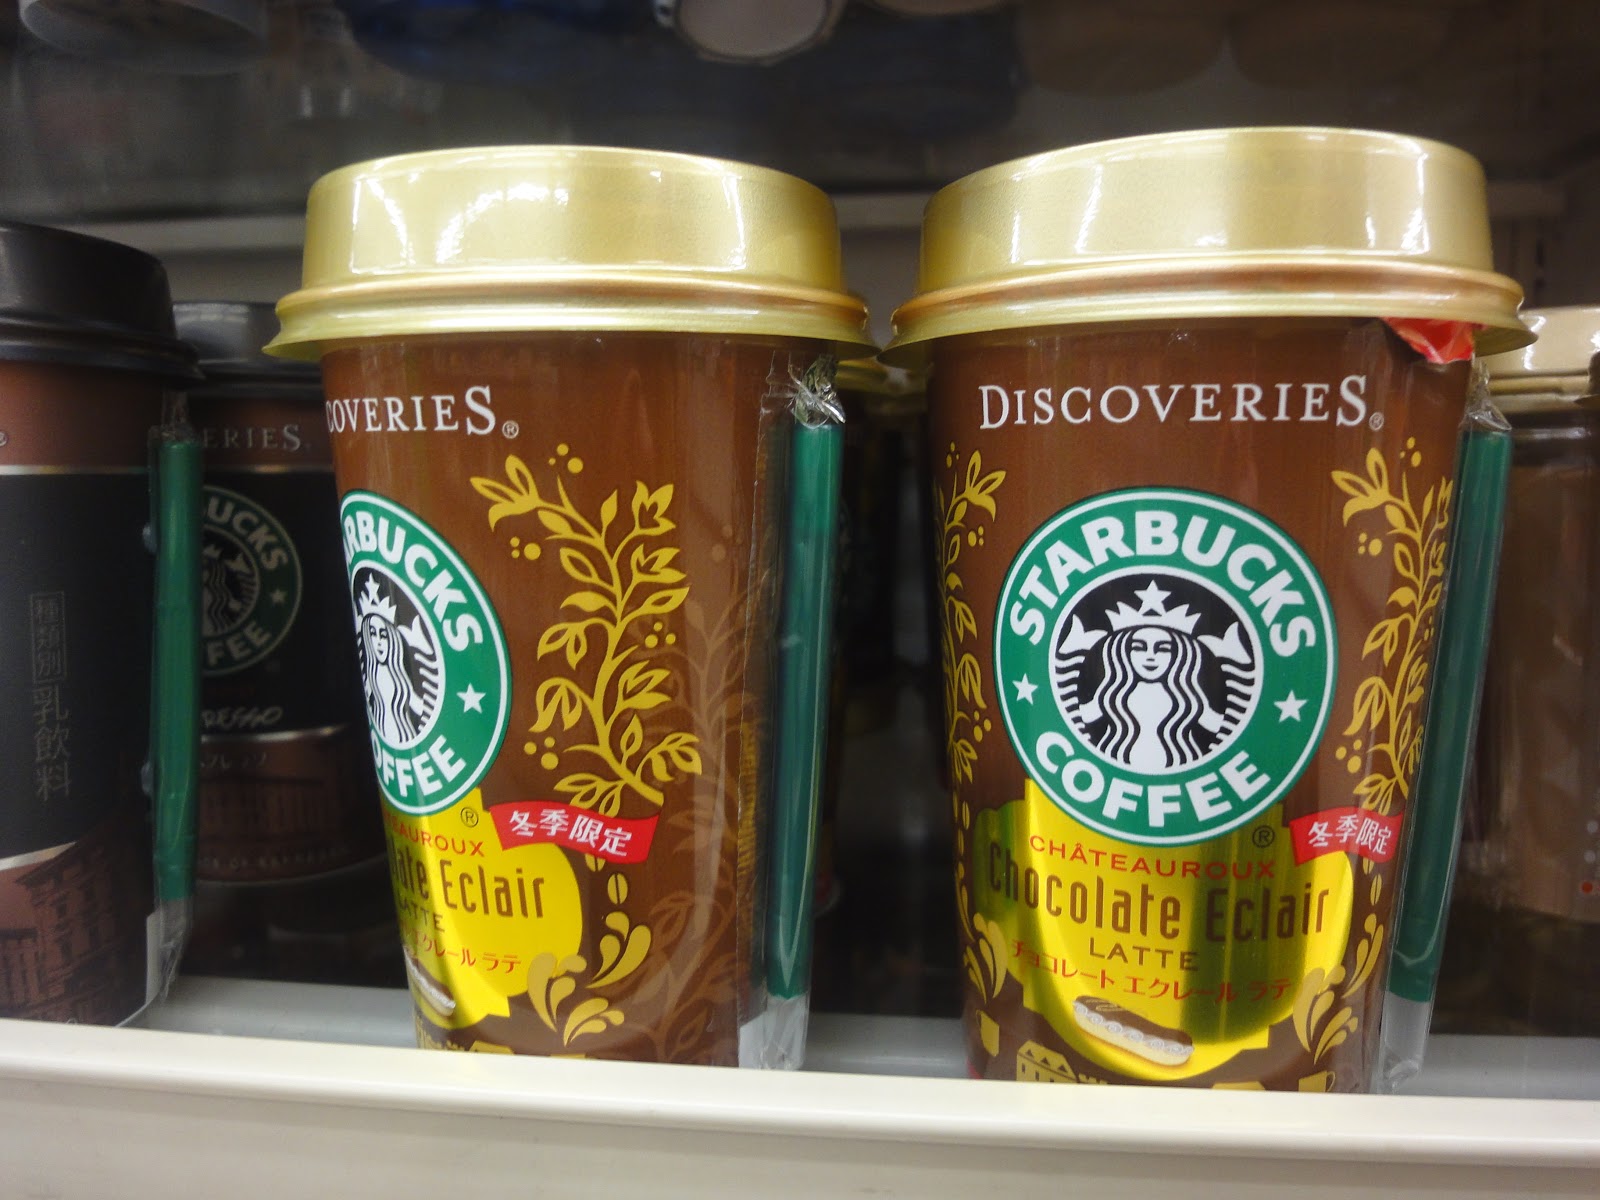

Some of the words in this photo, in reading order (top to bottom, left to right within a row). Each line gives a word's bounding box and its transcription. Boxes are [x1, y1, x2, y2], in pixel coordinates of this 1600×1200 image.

[978, 374, 1368, 430] DISCOVERIES
[203, 493, 289, 571] UCKS
[1009, 509, 1317, 658] STARBUCKS
[33, 684, 72, 802] 乳飲料
[1035, 731, 1271, 828] COFFEE
[509, 807, 633, 858] 冬季限定
[1029, 835, 1275, 880] CHÂTEAUROUX
[1307, 812, 1393, 857] 冬季限定
[438, 857, 546, 919] Eclair
[988, 841, 1181, 940] Chocolate
[1205, 883, 1330, 943] Eclair
[482, 951, 521, 975] ラテ
[1011, 939, 1116, 990] チョコレート
[1123, 975, 1239, 1003] エクレール
[1249, 977, 1293, 1001] ラテ
[1089, 937, 1200, 972] LATTE
